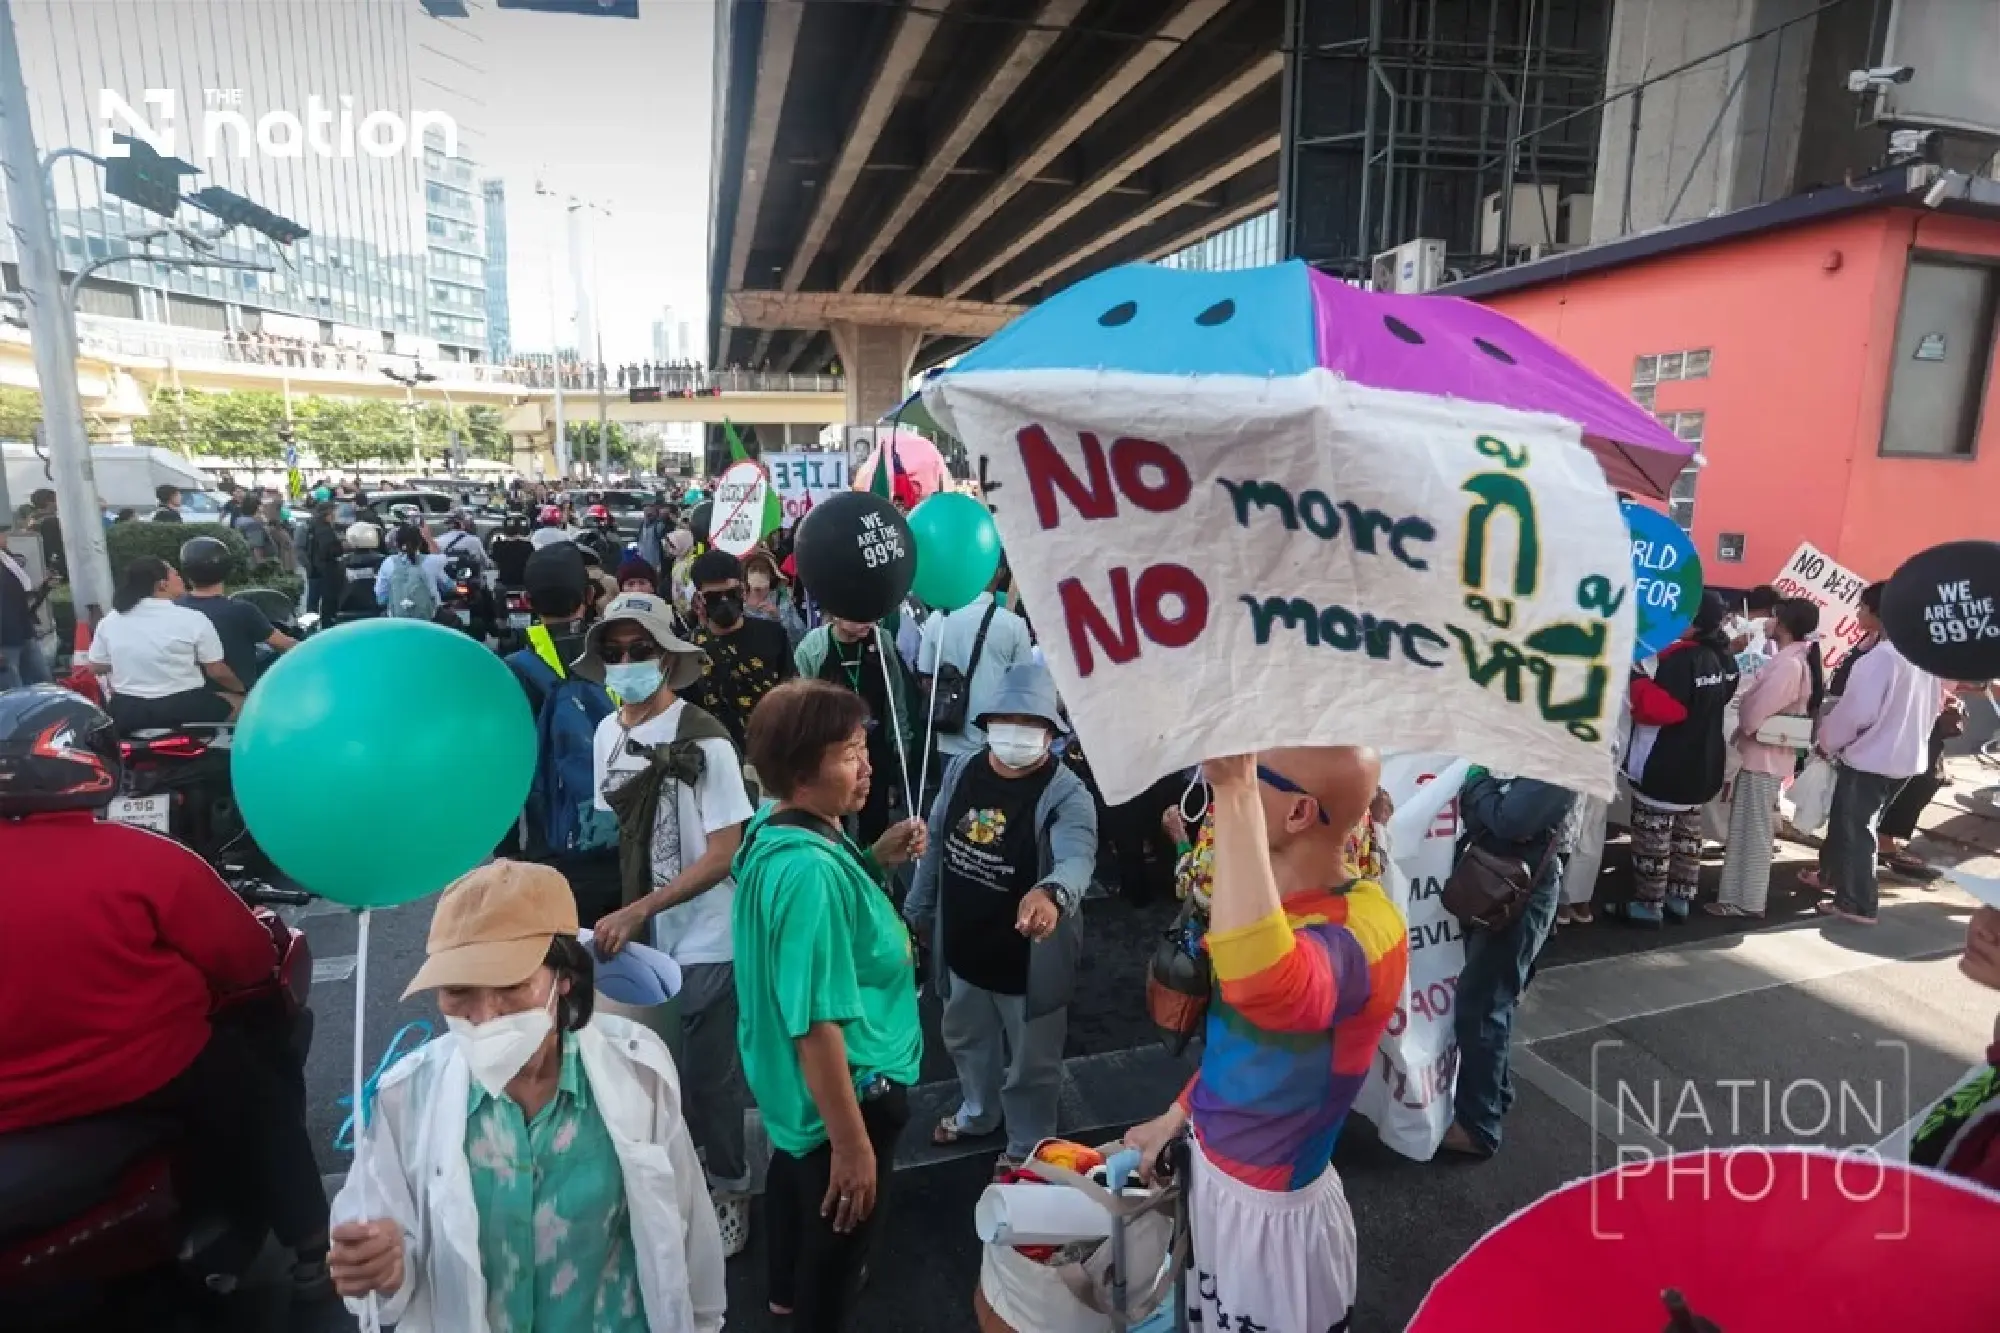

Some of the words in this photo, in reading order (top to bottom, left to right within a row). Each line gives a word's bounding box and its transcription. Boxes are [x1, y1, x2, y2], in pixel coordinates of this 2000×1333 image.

[1016, 423, 1194, 530] NO
[1216, 476, 1437, 571] more
[859, 511, 883, 529] WE
[1459, 434, 1543, 629] กู้
[857, 530, 880, 548] ARE
[879, 524, 898, 540] THE
[863, 539, 905, 568] 99%
[1631, 540, 1678, 571] RLD
[1792, 549, 1825, 580] NO
[1635, 577, 1682, 612] FOR
[1937, 580, 1972, 603] WE
[1057, 562, 1209, 678] NO
[1237, 594, 1449, 669] more
[1924, 603, 1956, 621] ARE
[1959, 597, 1994, 617] THE
[1929, 613, 2000, 644] 99%
[1443, 574, 1627, 743] หนี้
